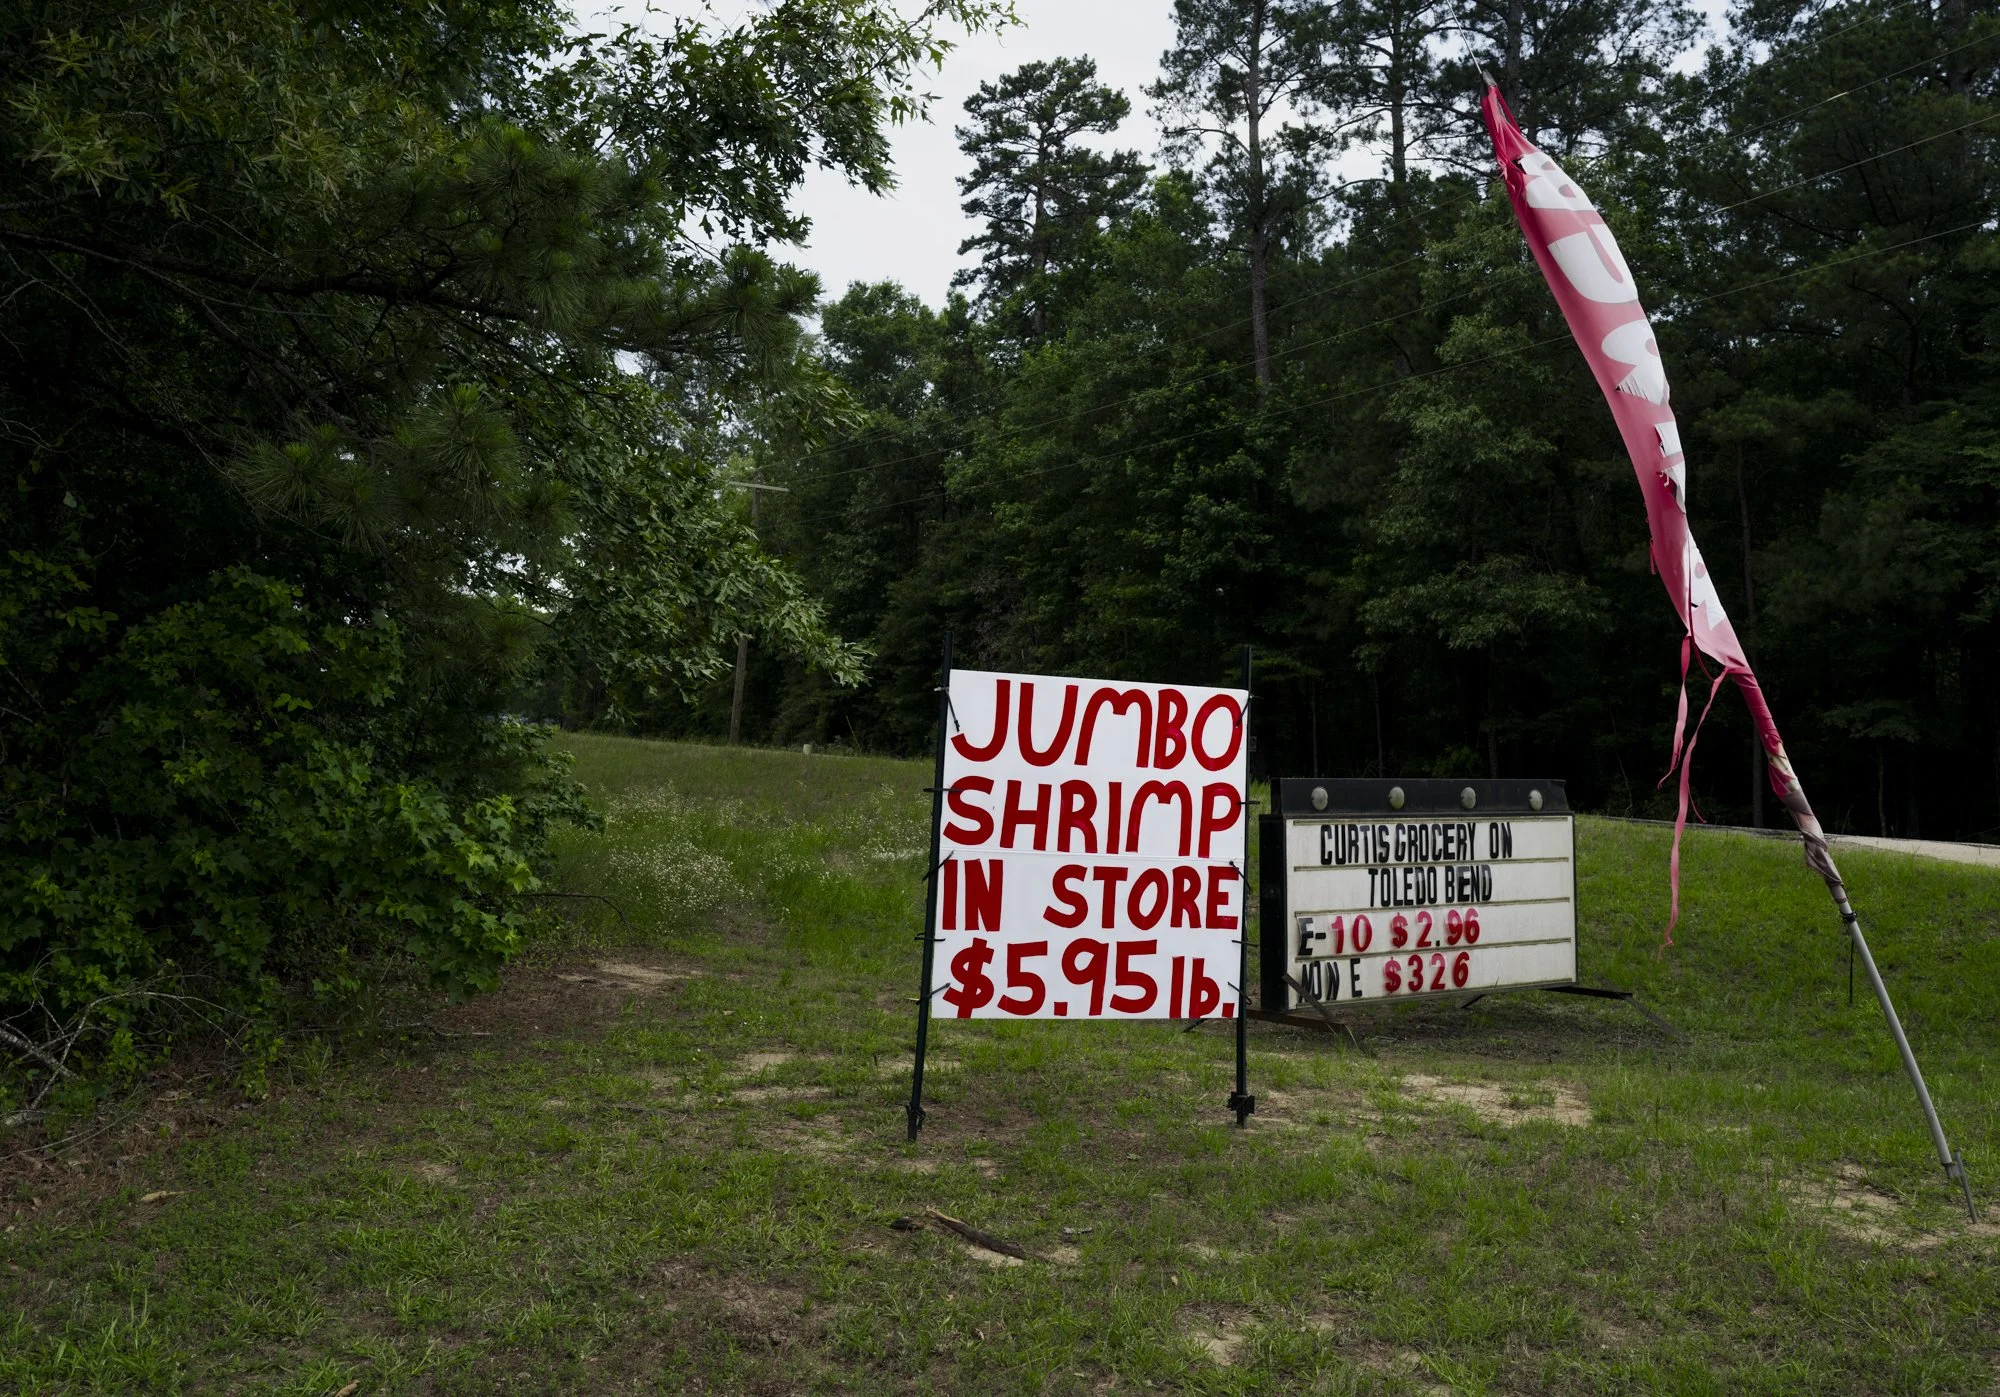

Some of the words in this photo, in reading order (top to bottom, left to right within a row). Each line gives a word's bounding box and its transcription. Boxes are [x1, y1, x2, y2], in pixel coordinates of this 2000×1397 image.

[950, 679, 1243, 772] JUMBO
[943, 775, 1242, 858] SHRIMP
[1320, 823, 1390, 865] CURTIS
[1394, 822, 1477, 863] GROCERY
[1489, 821, 1512, 859] ON
[942, 858, 1004, 931] IN
[1043, 864, 1239, 931] STORE
[1368, 865, 1437, 907] TOLEDO
[1445, 864, 1492, 903] BEND
[1391, 907, 1480, 949] $2.96
[942, 937, 1158, 1019] $5.95
[1384, 951, 1470, 993] $326
